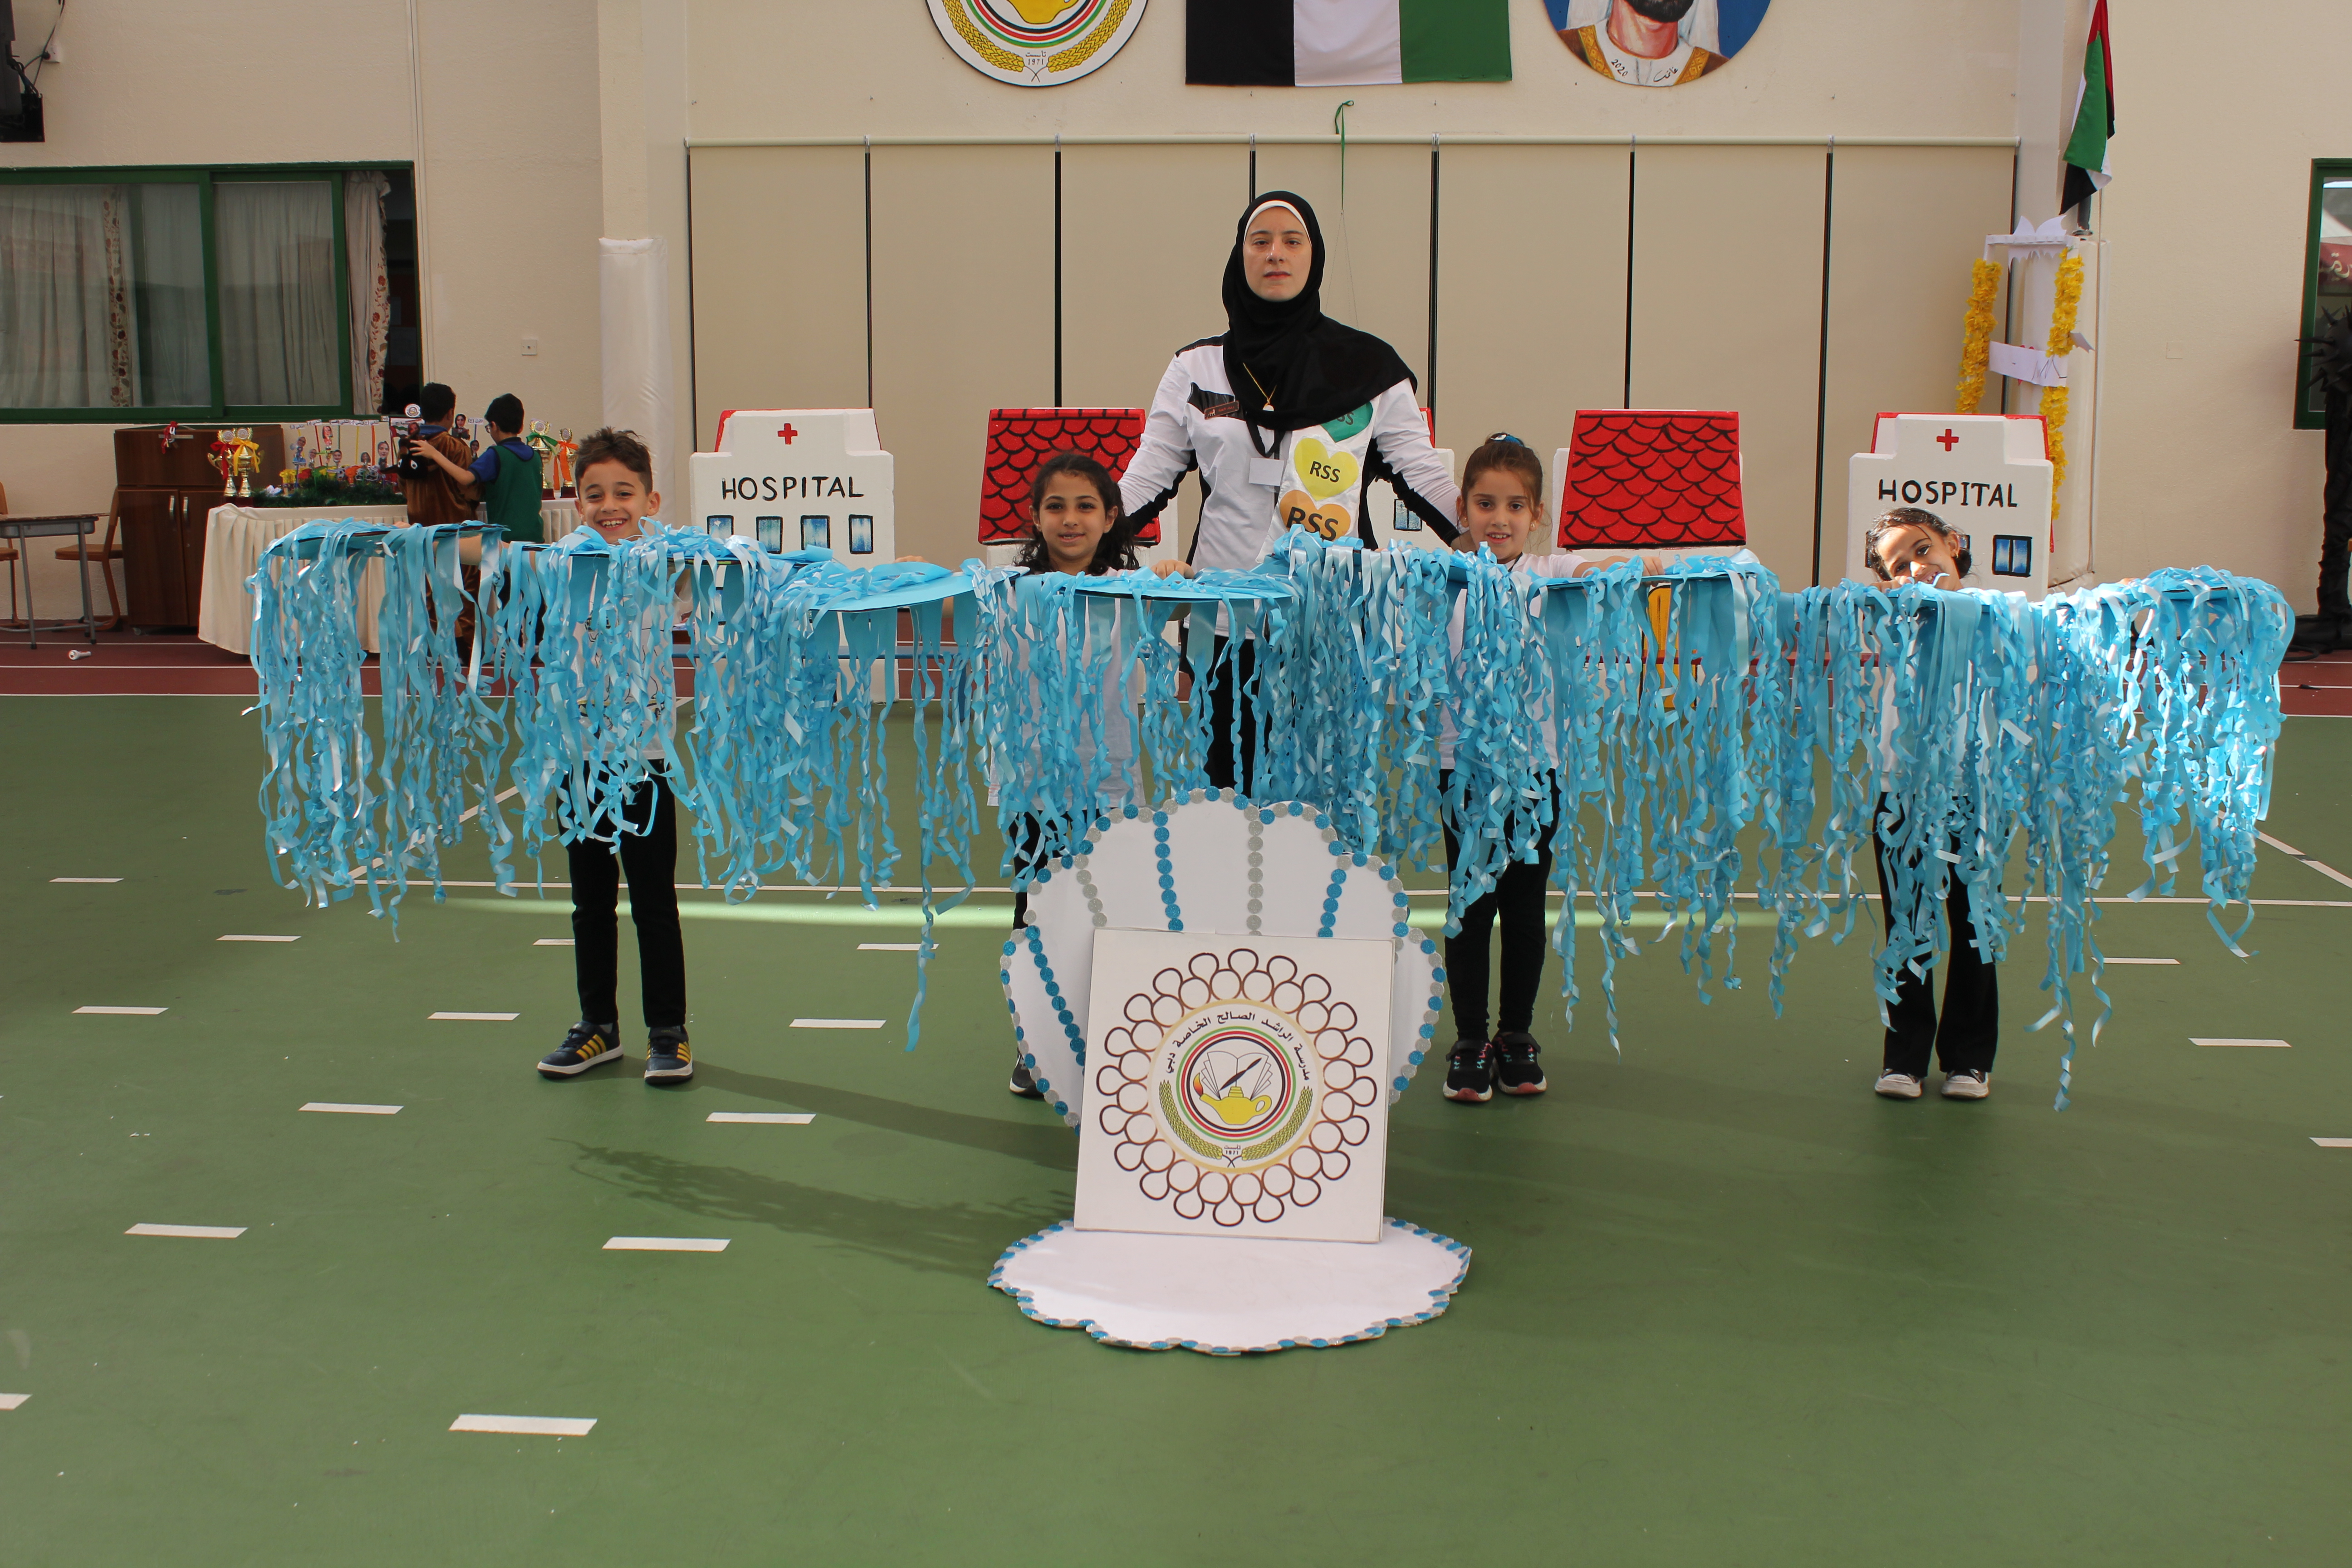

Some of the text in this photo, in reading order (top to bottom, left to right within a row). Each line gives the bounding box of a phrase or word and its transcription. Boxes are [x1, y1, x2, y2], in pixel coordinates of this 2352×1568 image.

[1611, 59, 1628, 76] 2020
[1309, 461, 1340, 483] RSS
[722, 476, 864, 501] HOSPITAL
[1878, 479, 2018, 507] HOSPITAL
[1286, 506, 1338, 541] RSS
[1217, 1011, 1255, 1024] الصالح
[1261, 1019, 1294, 1042] الراشد
